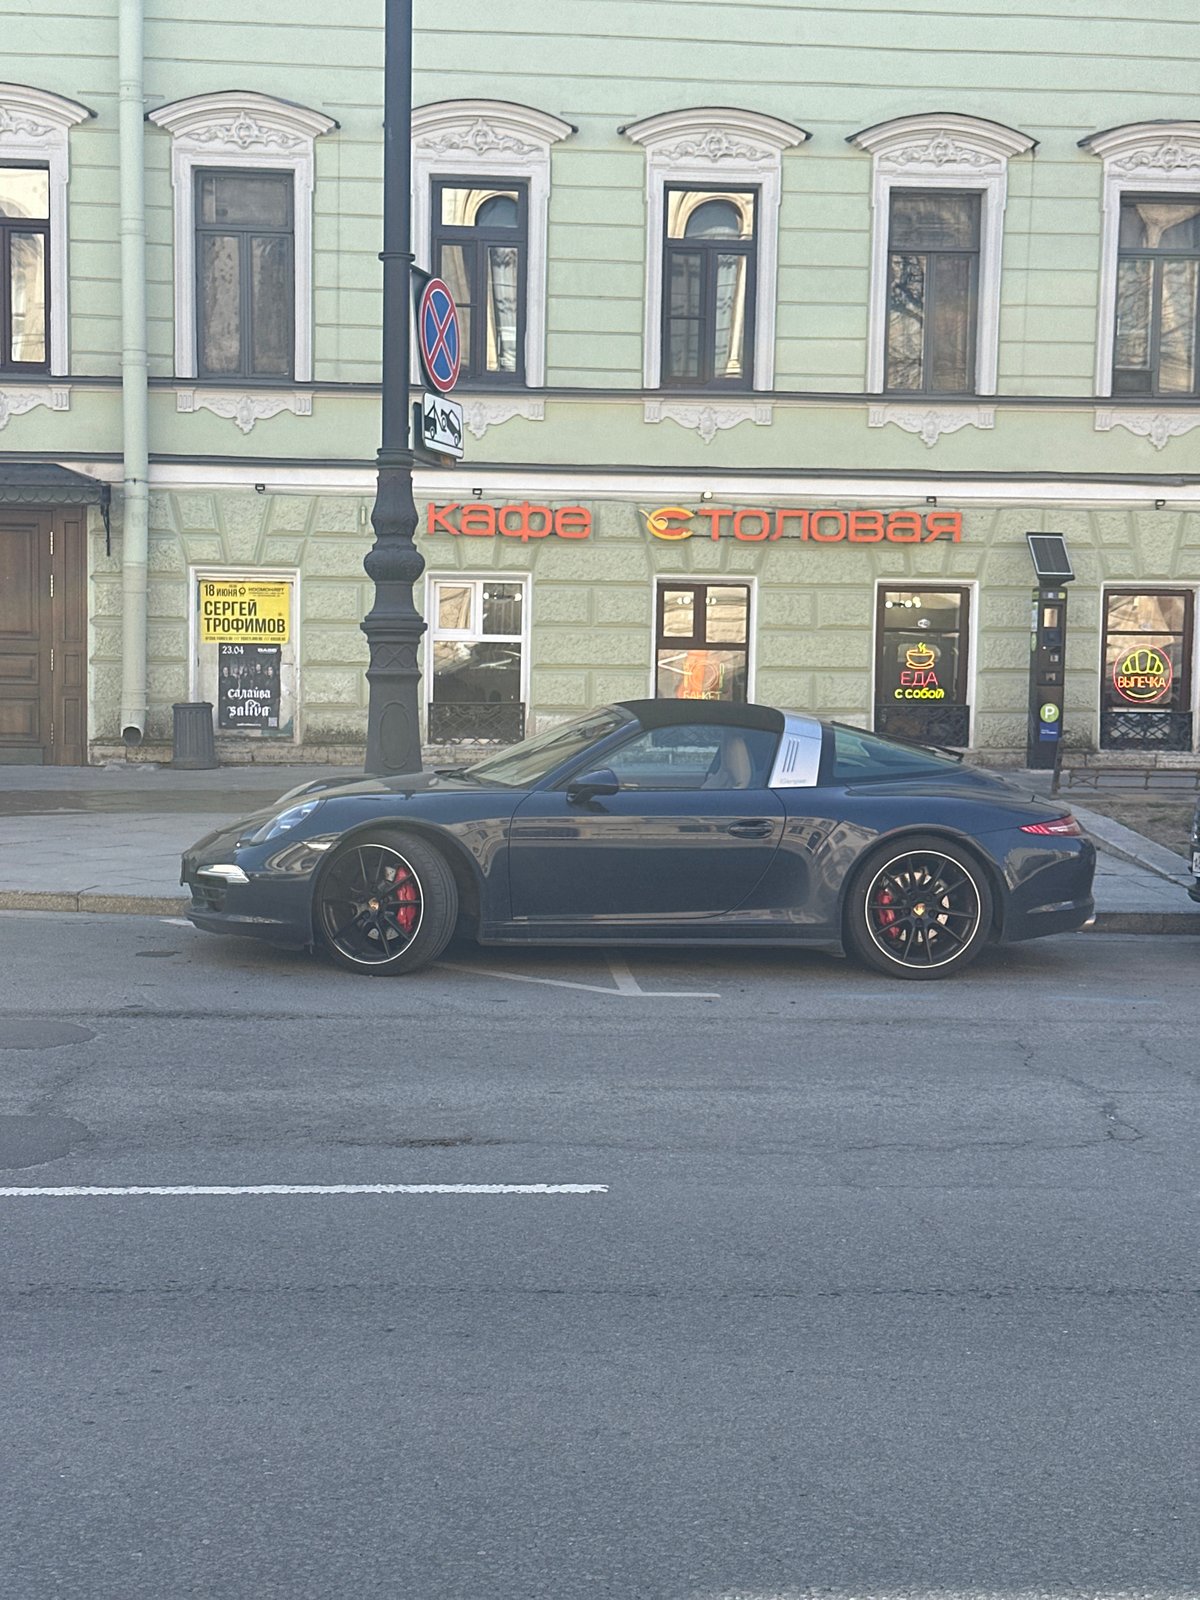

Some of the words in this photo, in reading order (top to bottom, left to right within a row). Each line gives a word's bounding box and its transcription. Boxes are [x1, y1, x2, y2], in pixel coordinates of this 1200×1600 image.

[204, 584, 215, 596] 18
[216, 588, 238, 597] ИЮНЯ
[204, 599, 257, 616] СЕРГЕЙ
[204, 617, 286, 633] ТРОФИМОВ
[222, 645, 244, 655] 23.04
[900, 671, 939, 687] ЕДА
[1117, 676, 1167, 689] ВЫПЕЧКА
[1044, 706, 1055, 719] P
